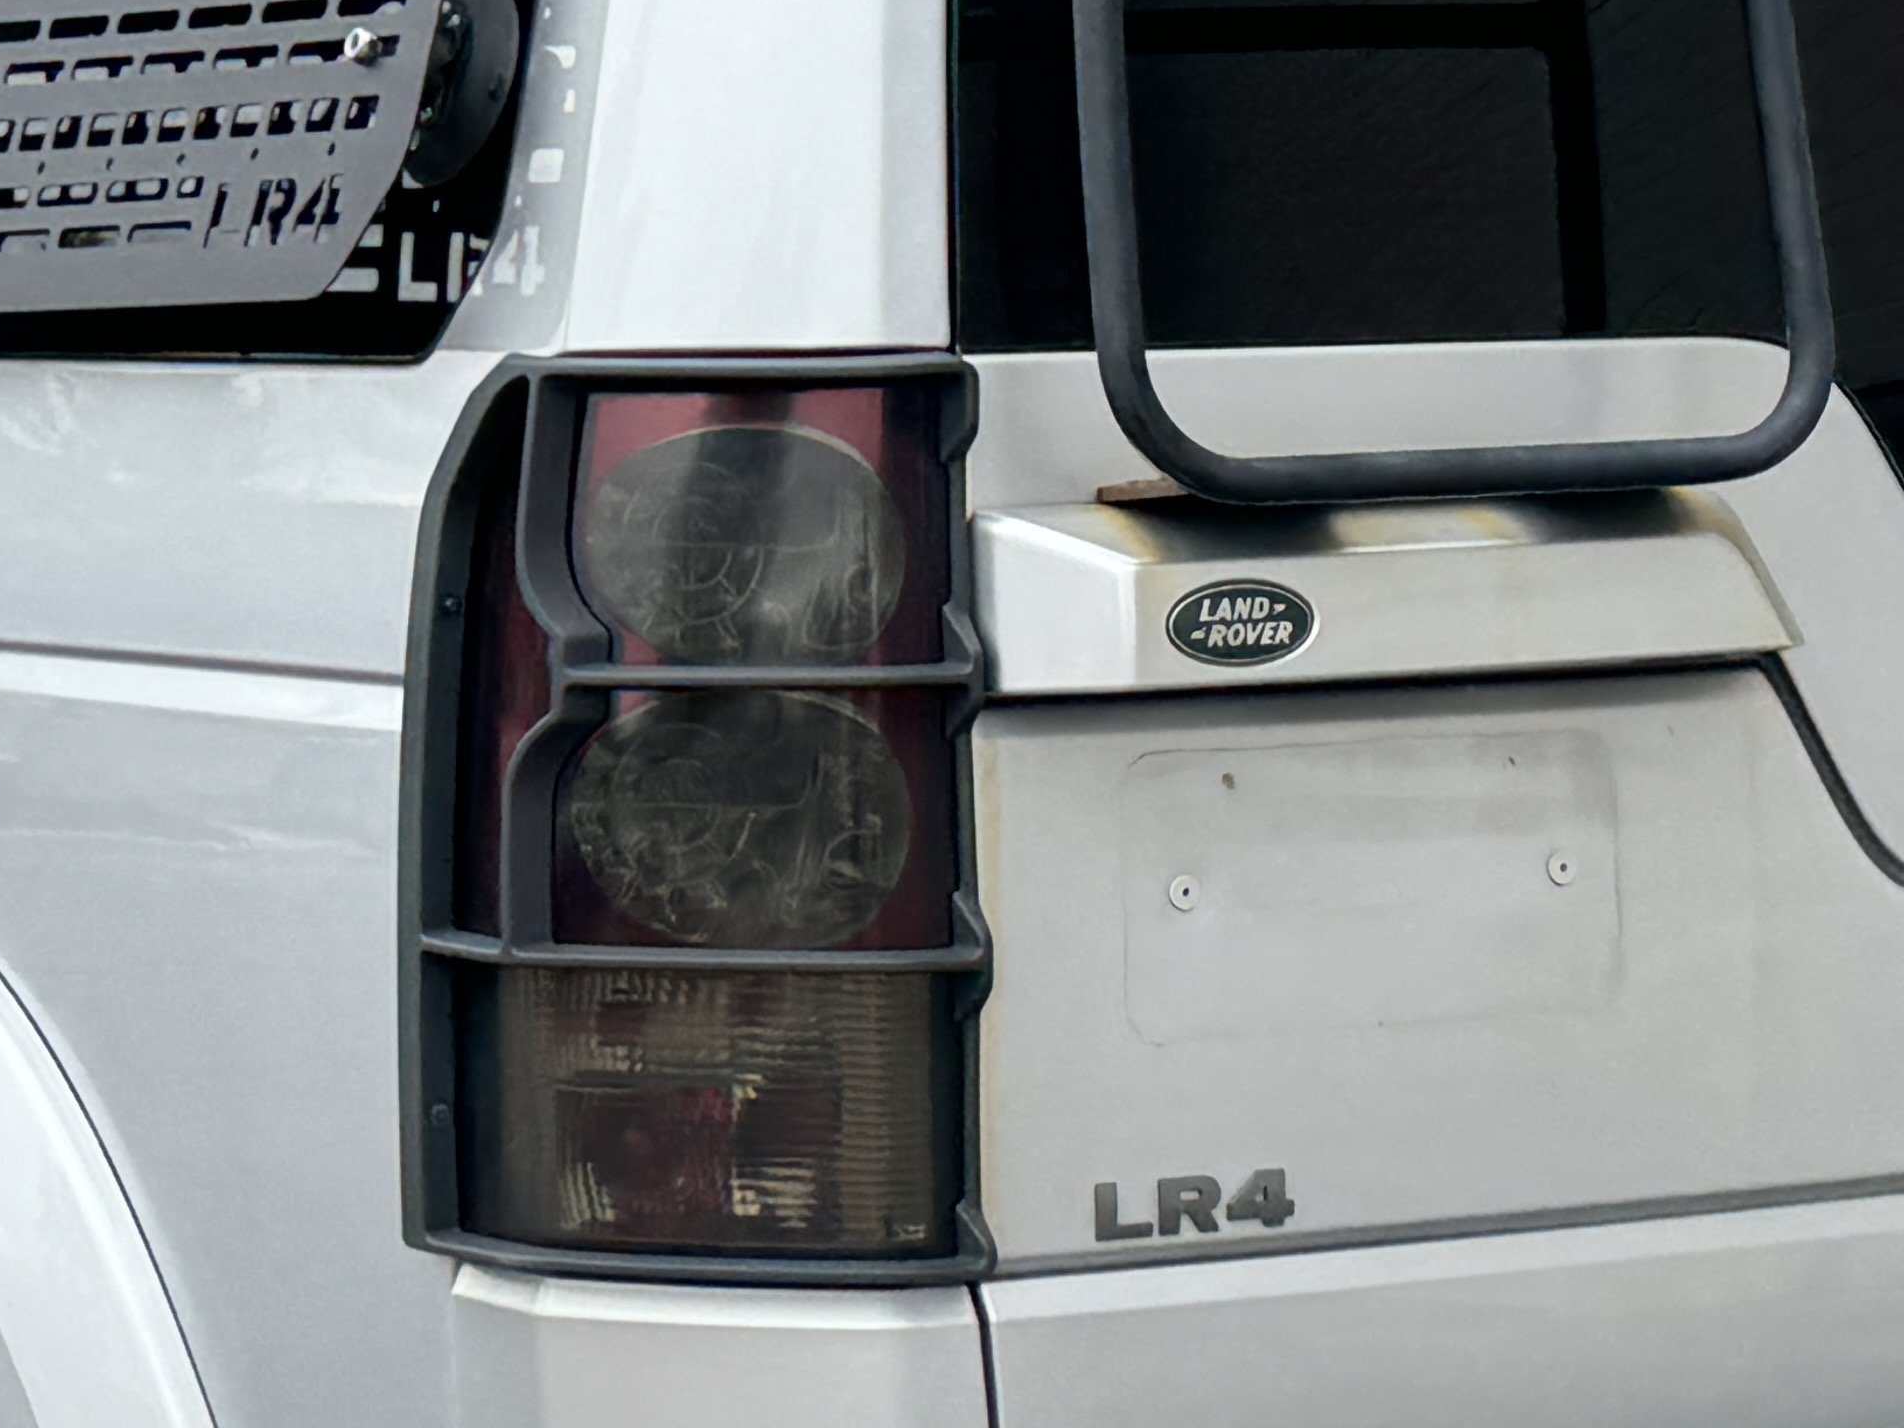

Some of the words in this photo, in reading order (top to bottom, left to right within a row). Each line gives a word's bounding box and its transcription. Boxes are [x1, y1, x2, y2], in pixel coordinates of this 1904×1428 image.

[203, 173, 343, 249] LR4
[1199, 597, 1270, 622] LAND
[1207, 621, 1294, 648] ROVER
[1094, 1168, 1295, 1241] LR4
